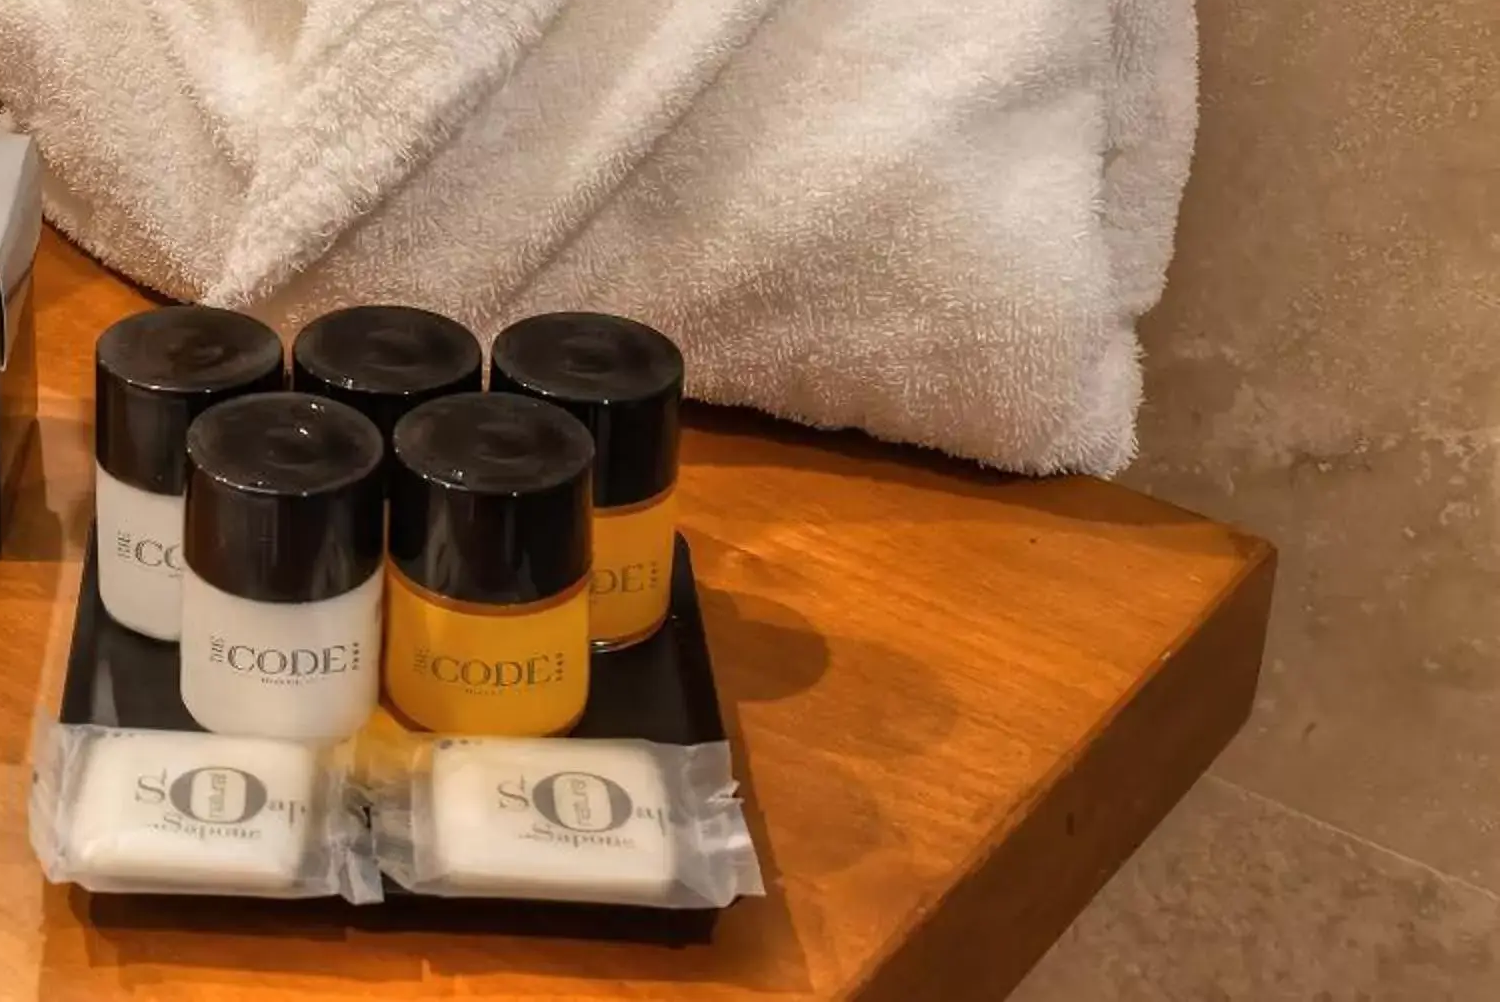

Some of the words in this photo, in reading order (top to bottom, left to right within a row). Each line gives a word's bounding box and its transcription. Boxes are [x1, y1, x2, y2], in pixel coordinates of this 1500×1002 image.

[135, 538, 183, 572] CO
[589, 563, 644, 595] DE
[227, 644, 347, 676] CODE
[431, 654, 551, 687] CODE
